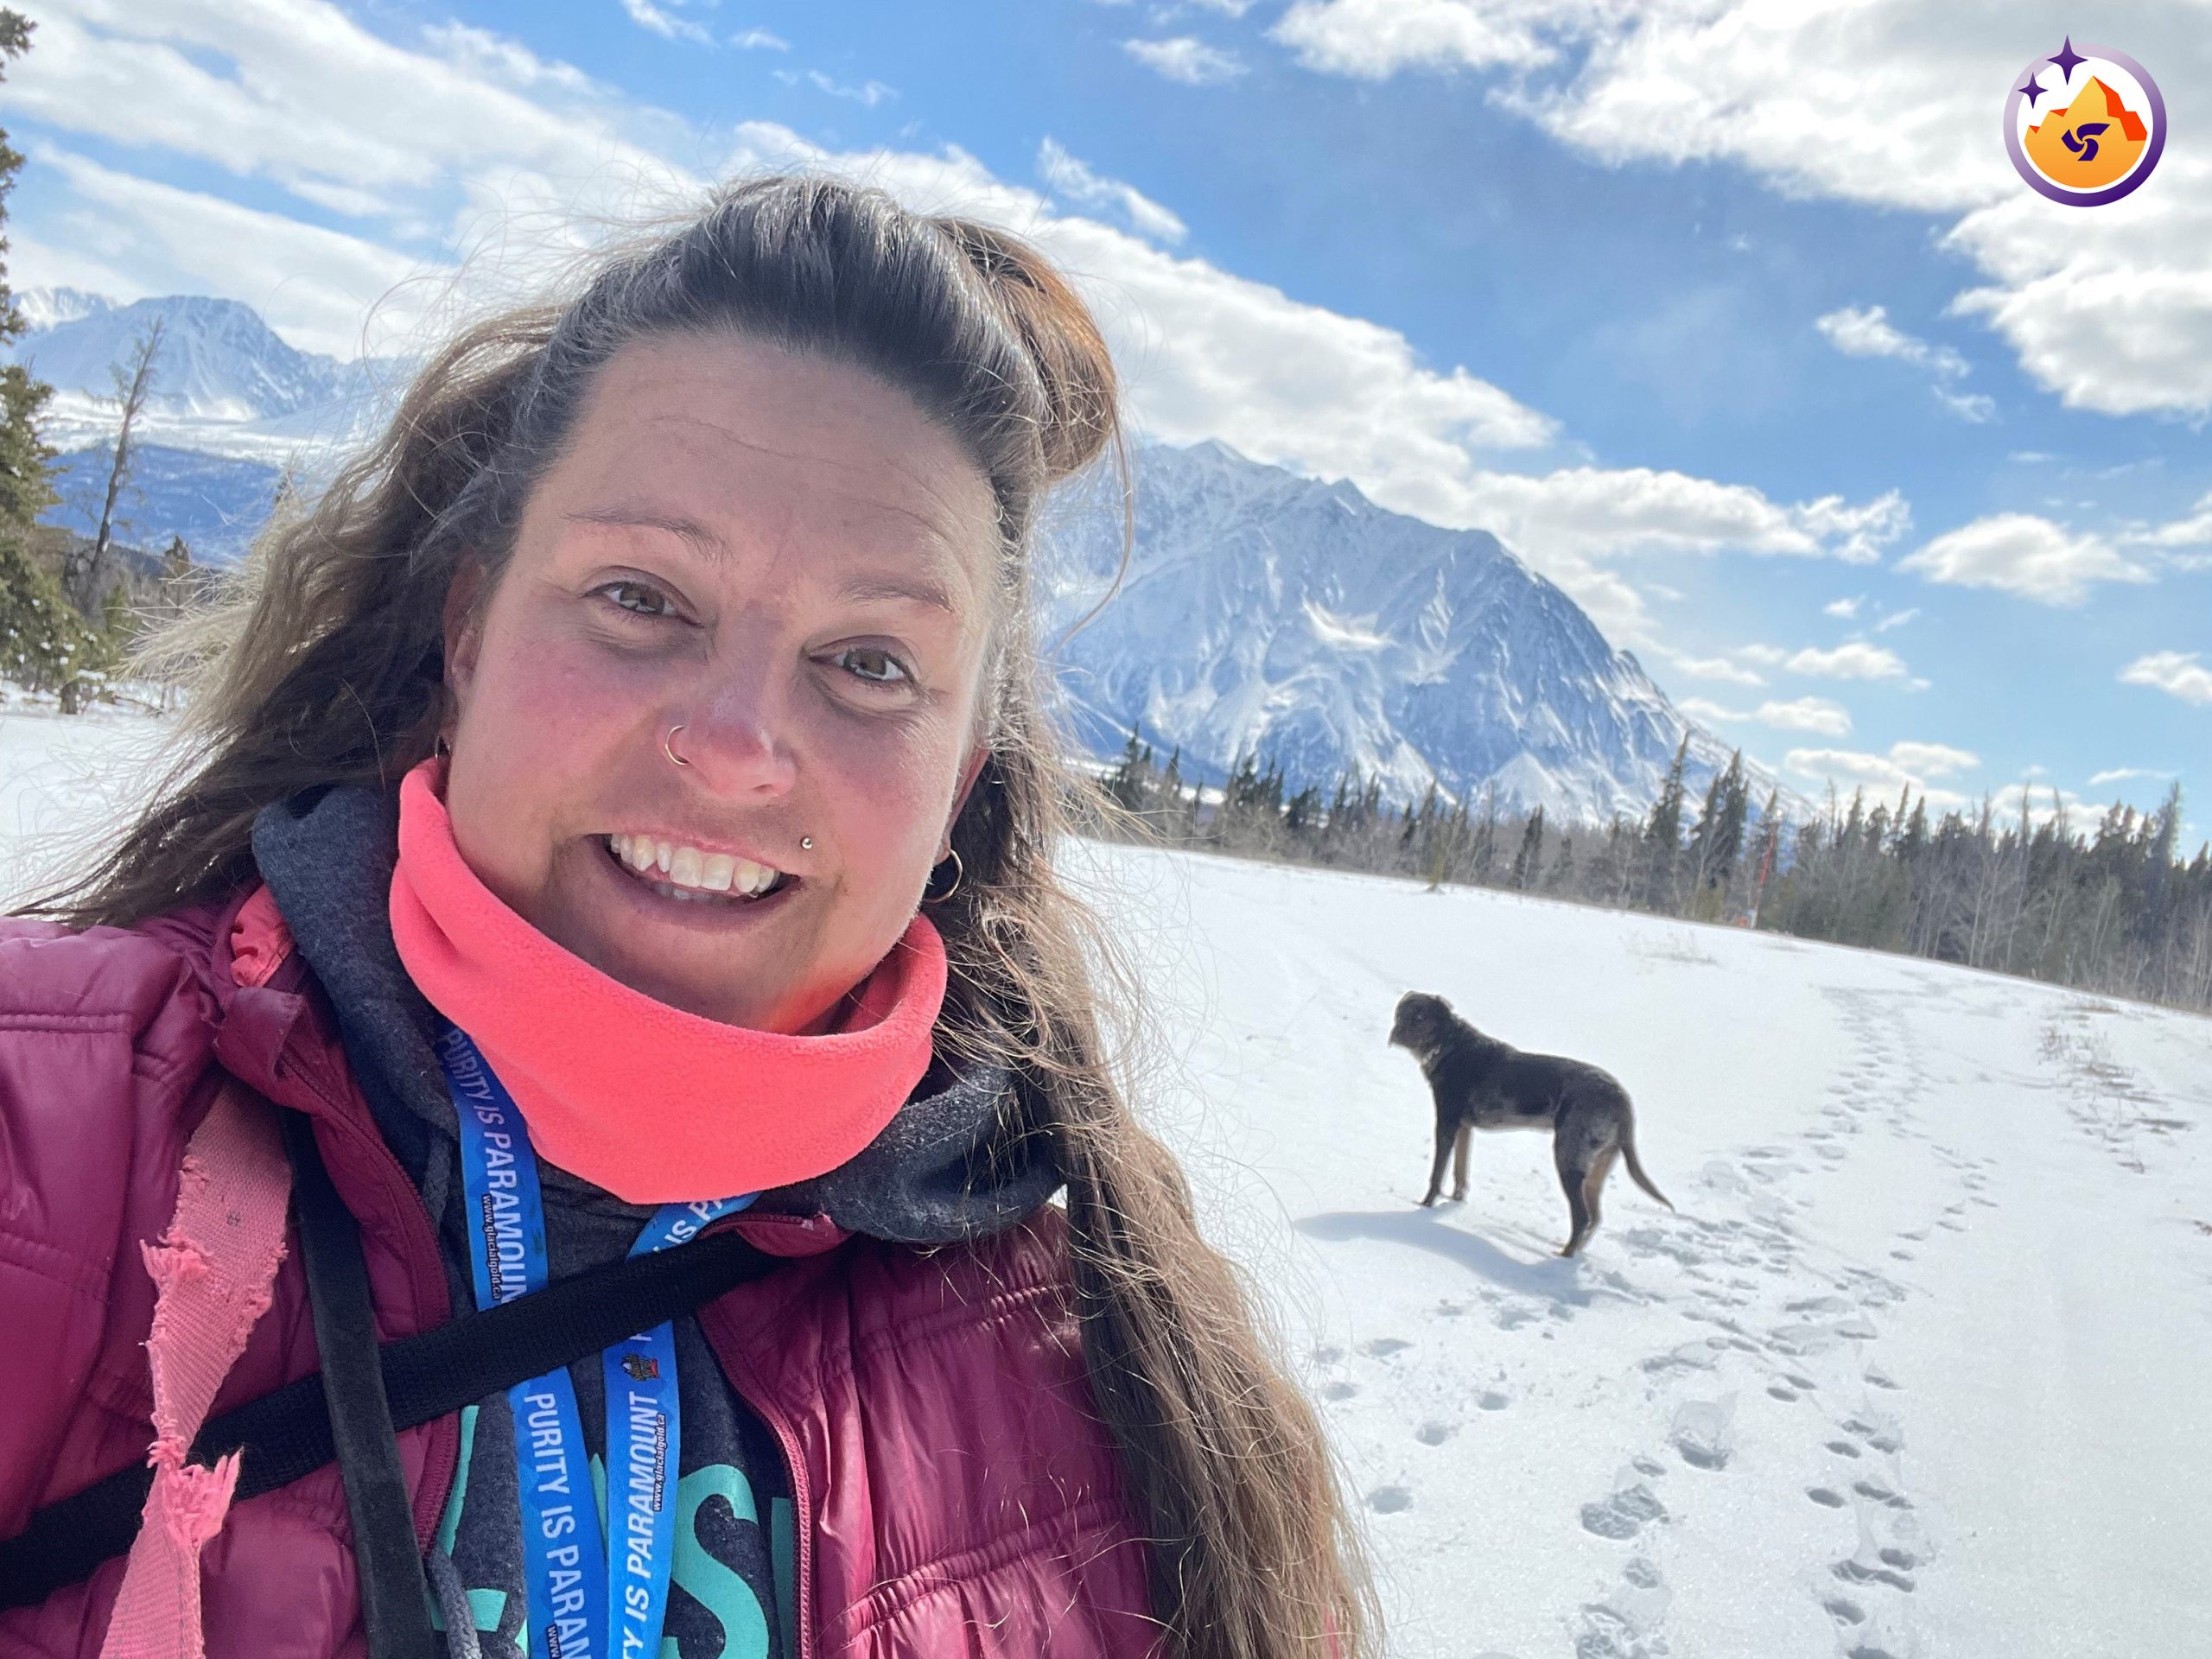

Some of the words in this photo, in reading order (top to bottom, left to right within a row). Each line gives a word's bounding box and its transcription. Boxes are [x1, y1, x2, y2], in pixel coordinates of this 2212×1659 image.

[442, 1028, 494, 1100] PURITY
[474, 1105, 505, 1125] IS
[482, 1195, 501, 1300] www.glacialgold.ca
[664, 1219, 697, 1244] IS
[688, 1200, 722, 1221] P
[524, 1393, 570, 1494] PURITY
[626, 1390, 658, 1579] PARAMOUNT
[653, 1414, 666, 1512] www.glacialgold.ca
[541, 1505, 575, 1539] IS
[625, 1585, 649, 1622] IS
